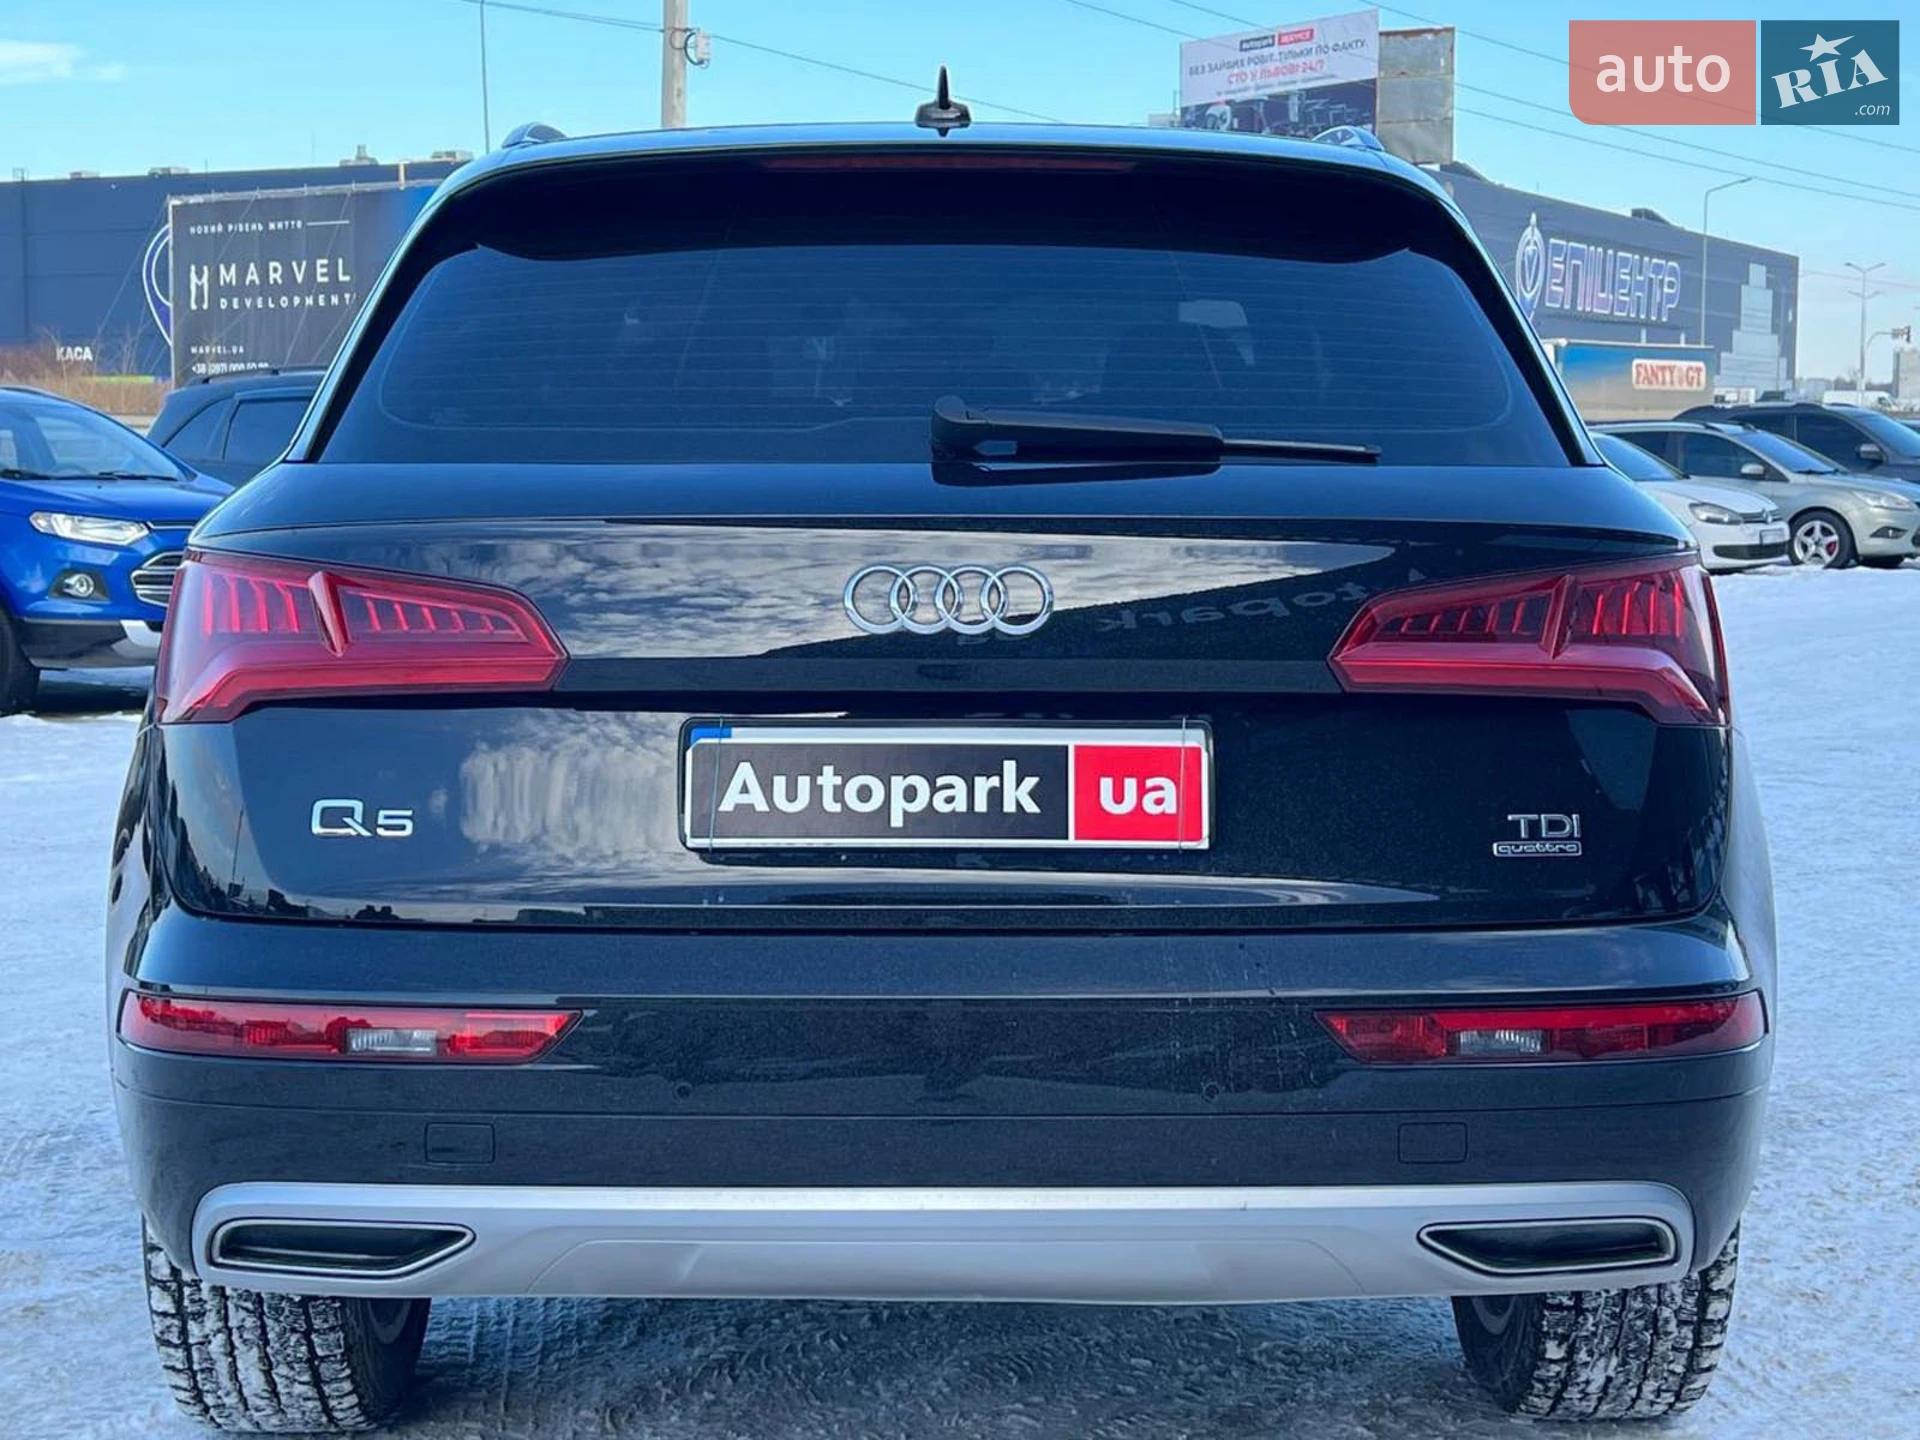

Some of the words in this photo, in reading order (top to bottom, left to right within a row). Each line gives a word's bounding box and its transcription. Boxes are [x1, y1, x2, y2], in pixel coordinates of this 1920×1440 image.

[1188, 64, 1206, 77] БЕЗ
[1315, 44, 1331, 56] ПО
[1227, 71, 1249, 85] СТО
[189, 222, 224, 235] НОВИЙ
[218, 257, 351, 287] MARVEL
[1544, 237, 1681, 323] ЕПІЦЕНТР
[219, 292, 352, 310] DEVELOPMENT
[1635, 362, 1676, 386] FANTY
[1685, 366, 1703, 388] GT
[718, 759, 1041, 828] Autopark
[1098, 775, 1178, 814] ua
[311, 798, 414, 837] Q5
[1507, 813, 1582, 839] TDI
[1498, 842, 1577, 855] quattro
